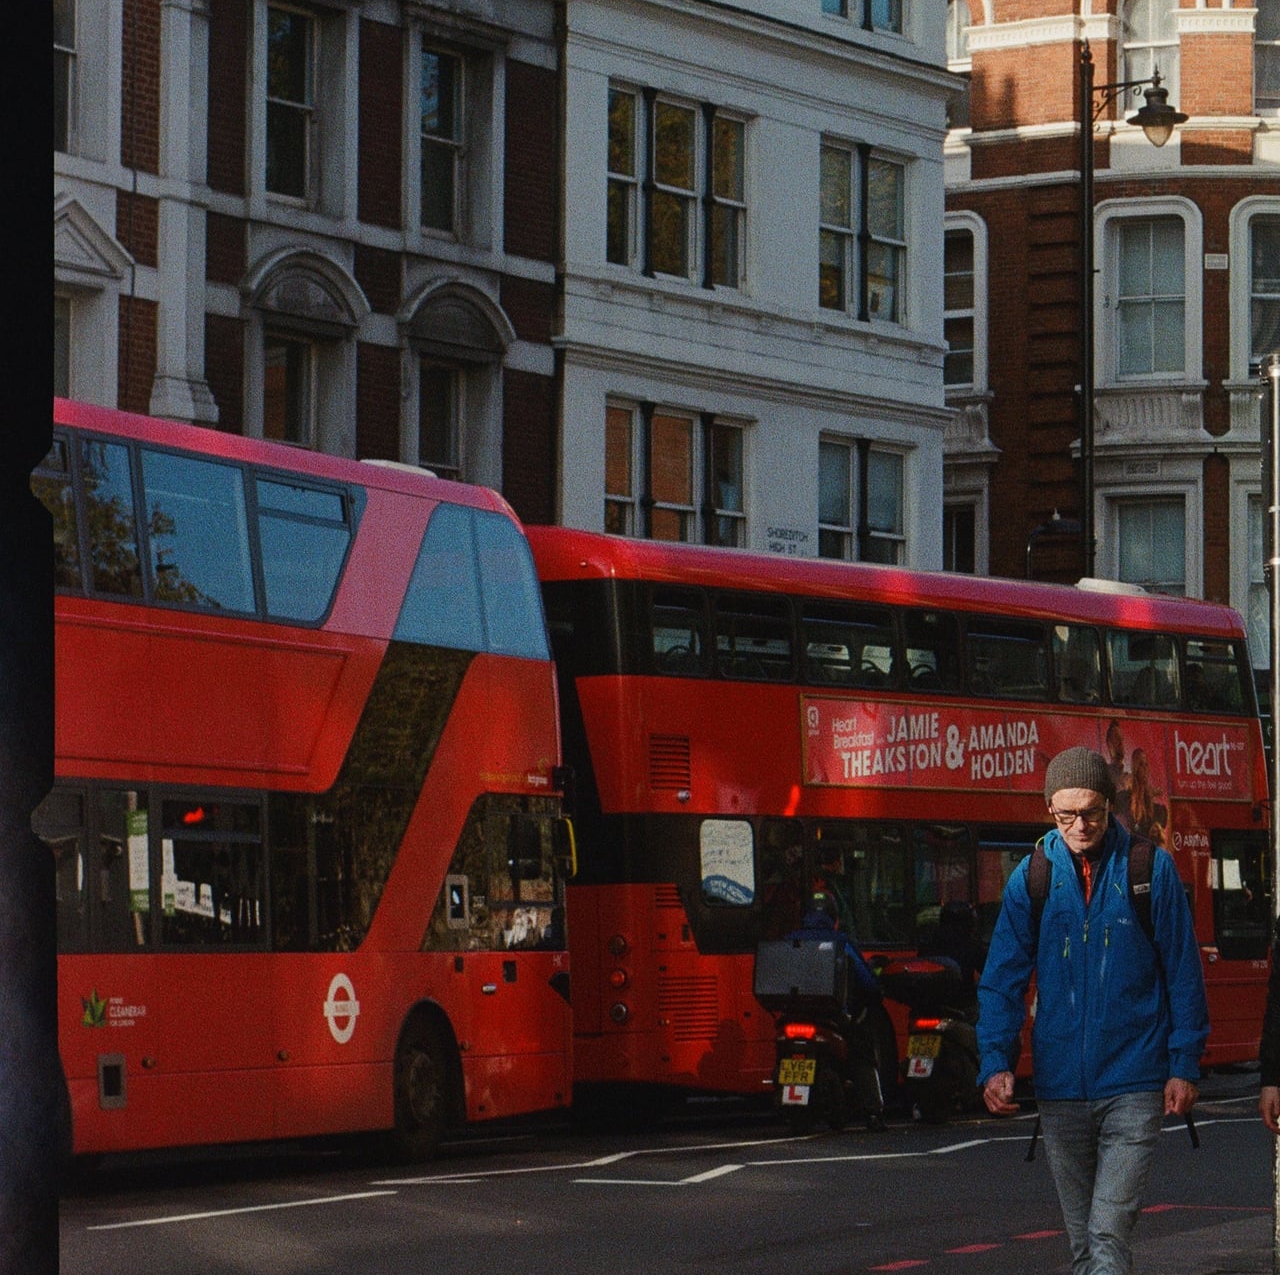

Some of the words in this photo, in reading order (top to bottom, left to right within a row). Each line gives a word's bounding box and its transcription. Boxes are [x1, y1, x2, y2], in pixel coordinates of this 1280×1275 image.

[832, 717, 857, 733] Heart
[833, 731, 875, 750] Breakfast
[886, 712, 940, 744] JAMIE
[968, 720, 1040, 752] AMANDA
[841, 741, 943, 779] THEAKSTON
[945, 725, 965, 770] &
[971, 746, 1036, 780] HOLDEN
[1174, 730, 1232, 776] heart
[1183, 833, 1210, 847] ARRIVA
[788, 1085, 804, 1101] L
